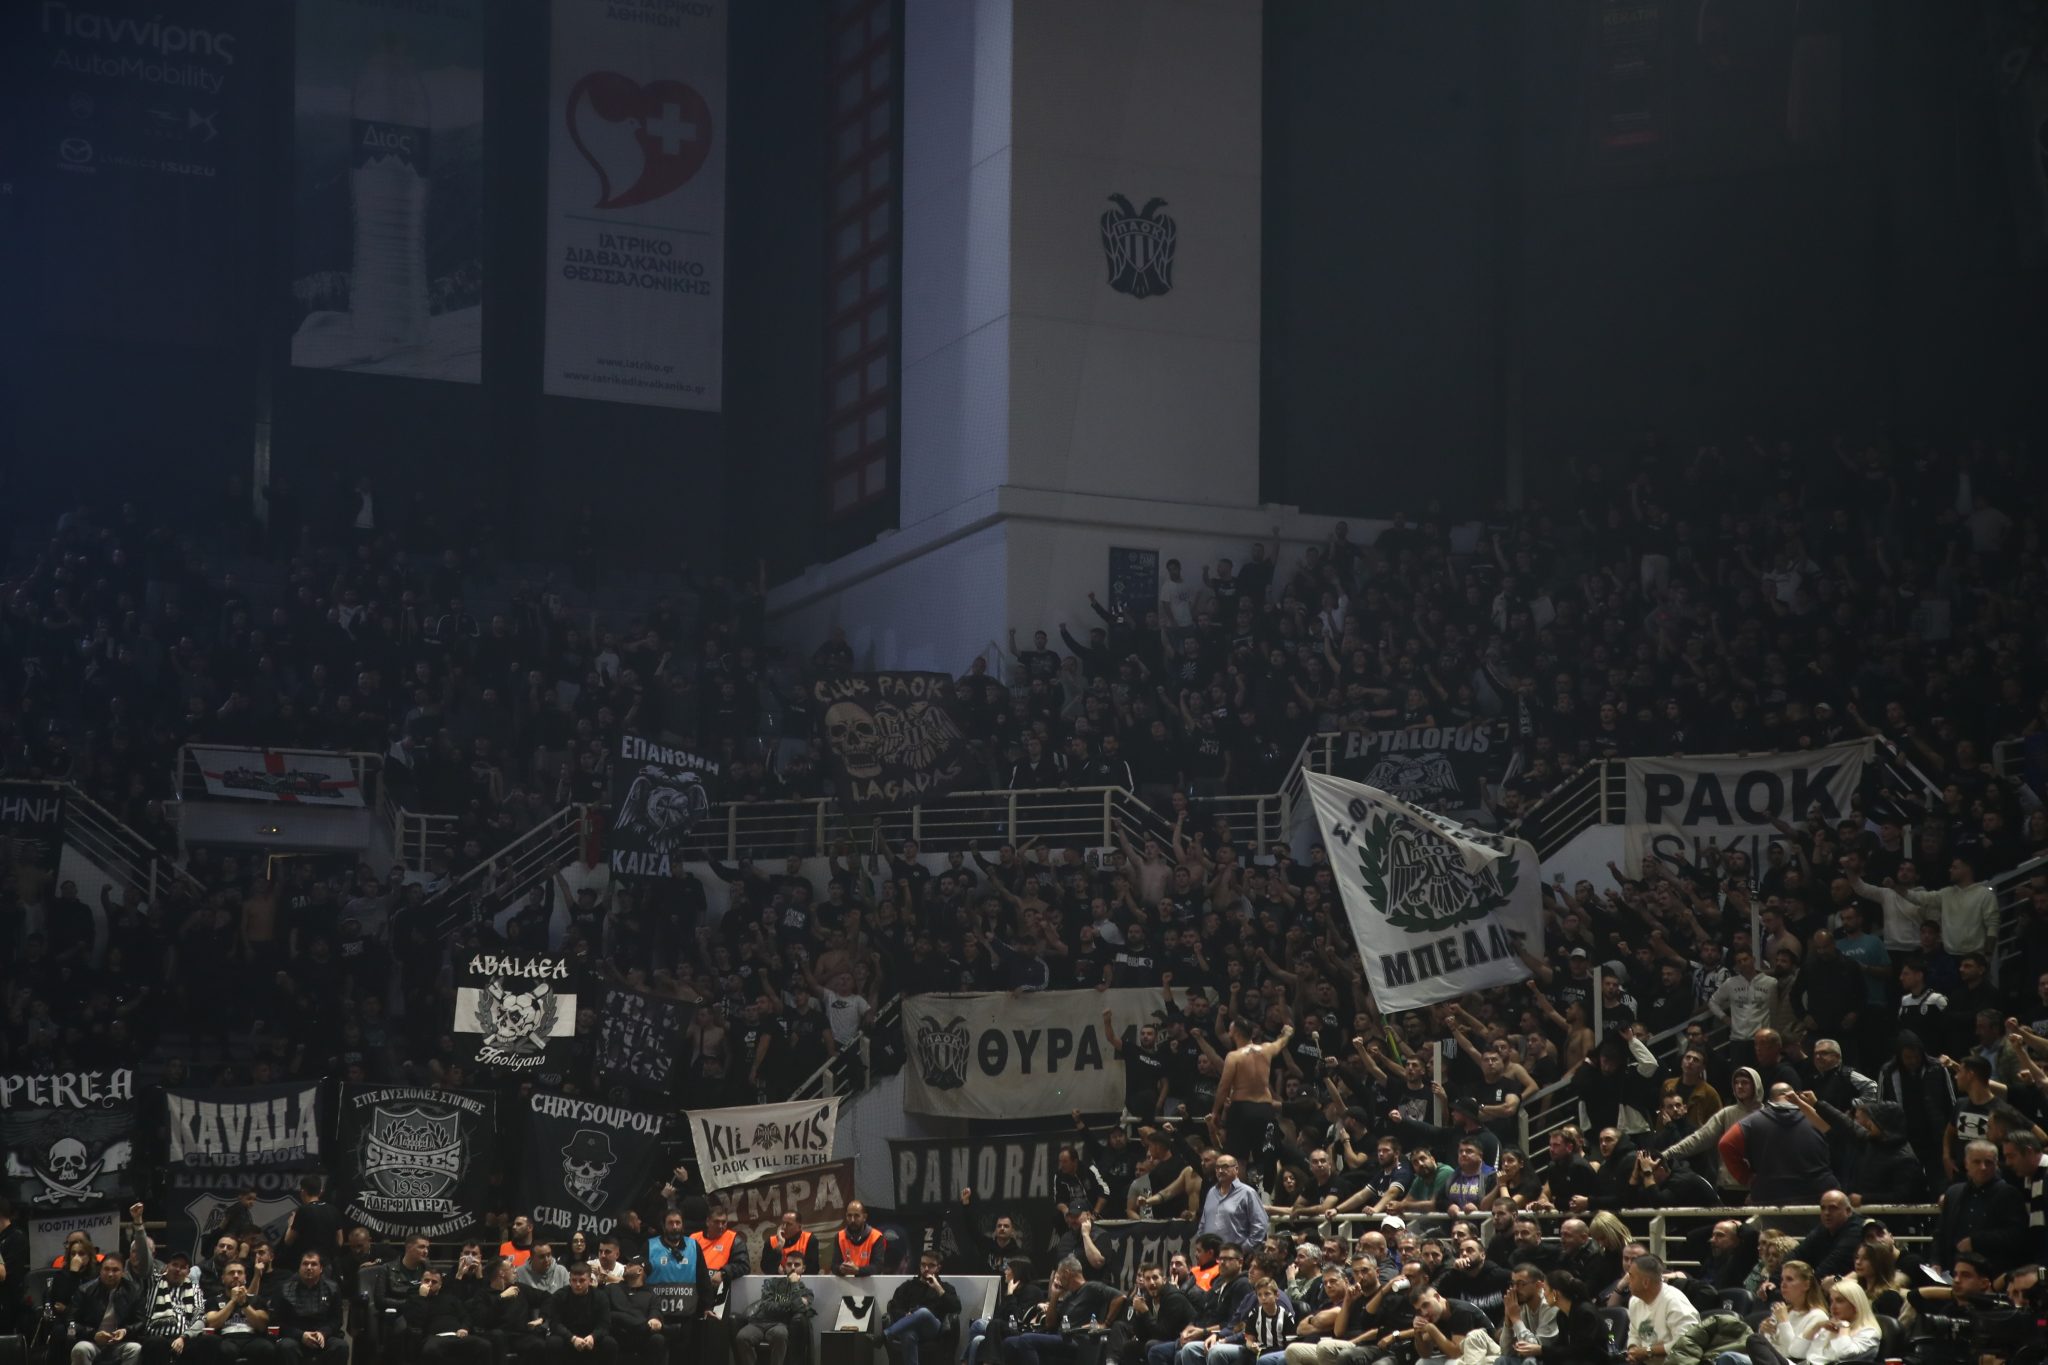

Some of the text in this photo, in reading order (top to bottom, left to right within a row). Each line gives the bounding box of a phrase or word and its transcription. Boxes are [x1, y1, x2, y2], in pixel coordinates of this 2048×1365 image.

[51, 49, 224, 94] AutoMobility
[600, 233, 672, 256] ΙΑΤΡΙΚΟ
[565, 247, 704, 278] ΔΙΑΒΑΛΚΑΝΙΚΟ
[562, 265, 711, 295] ΘΕΣΣΑΛΟΝΙΚΗΣ
[878, 676, 944, 699] PAOK
[621, 735, 719, 776] ΕΠΑΝΟΜΗ
[1344, 724, 1491, 759] EPTALOFOS
[851, 760, 962, 802] LAGADAS
[1644, 765, 1842, 825] PAOK
[475, 1046, 545, 1072] Hooligans
[977, 1024, 1103, 1077] ΘΥΡΑ
[352, 1087, 486, 1116] ΣΤΙΣ ΔΥΣΚΟΛΕΣ ΣΤΙΓΜΕΣ
[531, 1093, 664, 1136] CHRYSOUPOLI
[166, 1086, 319, 1163] KAVALA
[184, 1145, 305, 1168] CLUB PAOK
[366, 1142, 460, 1173] SERRES
[713, 1152, 828, 1176] PAOK TILL DEATH
[392, 1180, 432, 1197] 1989
[899, 1142, 1084, 1205] PANORA
[78, 1215, 113, 1231] ΜΑΓΚΑ
[533, 1205, 618, 1236] CLUB PAO
[652, 1287, 694, 1296] SUPERVISOR
[660, 1298, 684, 1312] 014
